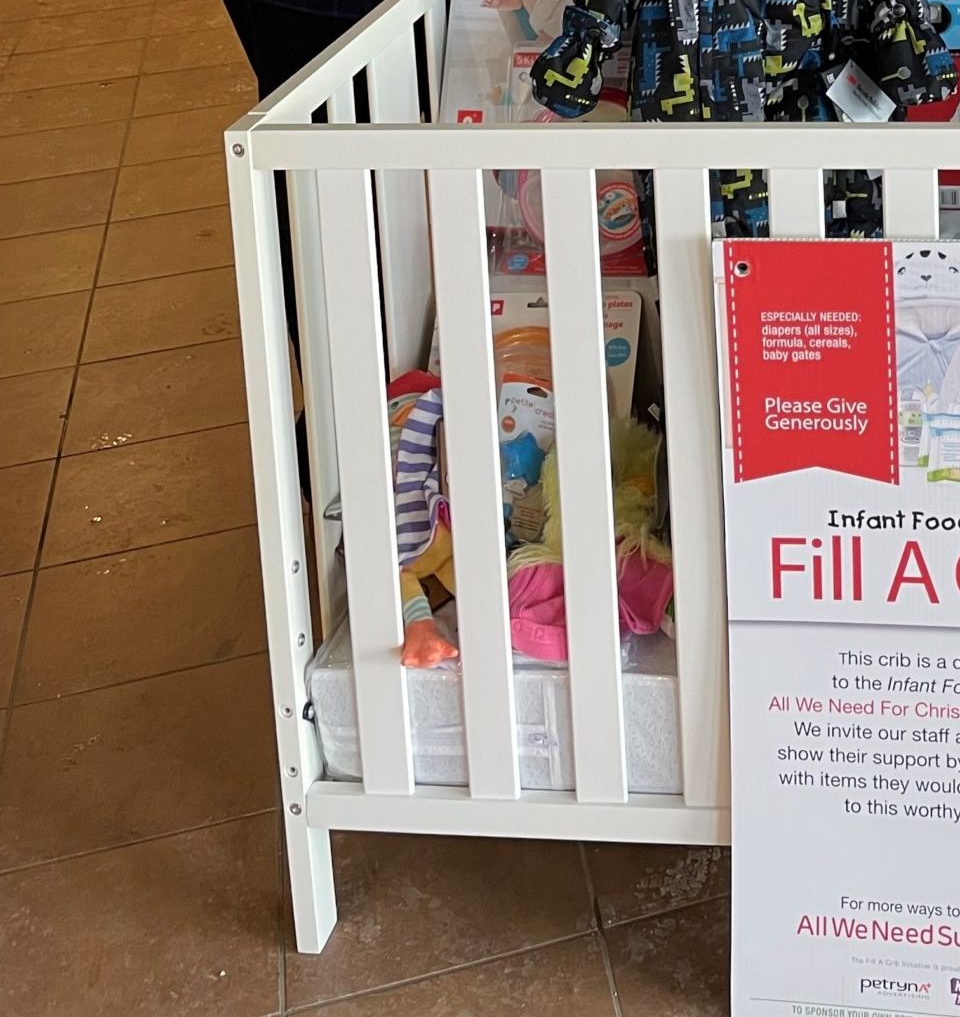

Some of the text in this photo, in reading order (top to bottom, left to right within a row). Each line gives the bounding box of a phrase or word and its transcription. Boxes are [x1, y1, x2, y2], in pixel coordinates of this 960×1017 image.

[608, 301, 633, 309] plates
[760, 311, 861, 323] ESPECIALLY NEEDED:
[762, 325, 857, 337] diapers (all sizes),
[763, 337, 850, 348] formula, cereals,
[763, 350, 821, 362] baby gates
[765, 397, 867, 413] Please Give
[766, 414, 868, 434] Generously
[828, 510, 905, 529] Infant
[772, 536, 862, 601] Fill
[887, 541, 939, 604] A
[839, 651, 872, 665] This
[879, 653, 910, 667] crib
[918, 653, 930, 668] is
[937, 658, 946, 669] a
[832, 675, 848, 689] to
[855, 676, 881, 690] the
[888, 677, 936, 693] Infant
[769, 697, 789, 711] All
[796, 697, 822, 712] We
[829, 699, 873, 714] Need
[881, 701, 909, 716] For
[794, 721, 821, 737] We
[828, 723, 872, 739] invite
[879, 729, 906, 740] our
[913, 728, 949, 743] staff
[778, 746, 823, 761] show
[830, 748, 867, 763] their
[873, 753, 940, 769] support
[779, 771, 813, 785] with
[821, 773, 866, 788] items
[873, 775, 909, 794] they
[845, 799, 861, 813] to
[867, 800, 897, 815] this
[841, 896, 863, 910] For
[868, 902, 902, 913] more
[907, 904, 942, 918] ways
[947, 905, 960, 917] to
[792, 1004, 803, 1015] TO
[805, 1006, 845, 1017] SPONSOR
[847, 1009, 870, 1017] YOUR
